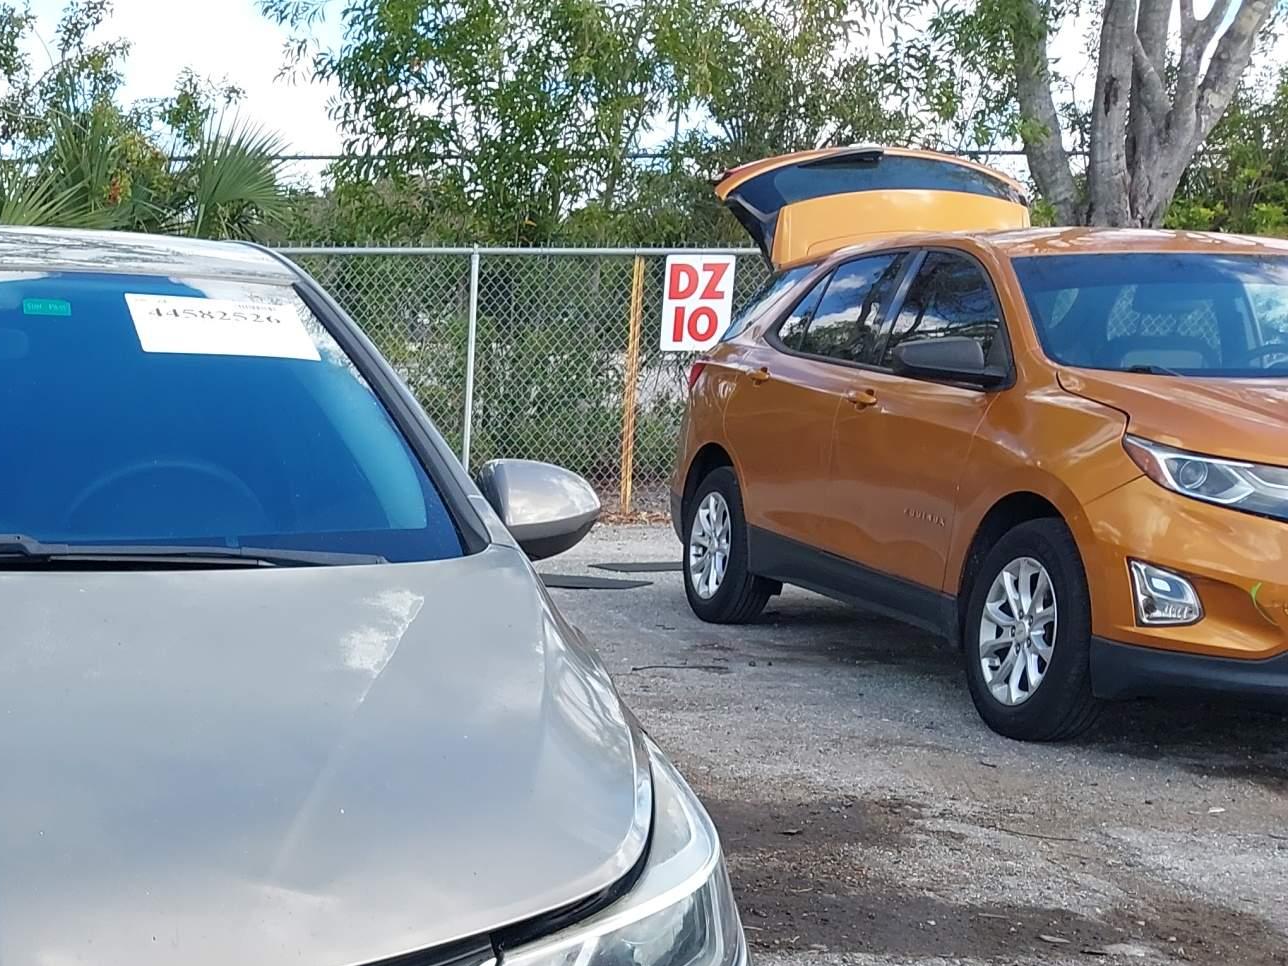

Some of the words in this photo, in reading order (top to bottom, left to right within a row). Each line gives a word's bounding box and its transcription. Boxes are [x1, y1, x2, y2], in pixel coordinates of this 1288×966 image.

[668, 262, 730, 300] DZ
[149, 307, 282, 325] 44582526
[672, 305, 719, 342] 10
